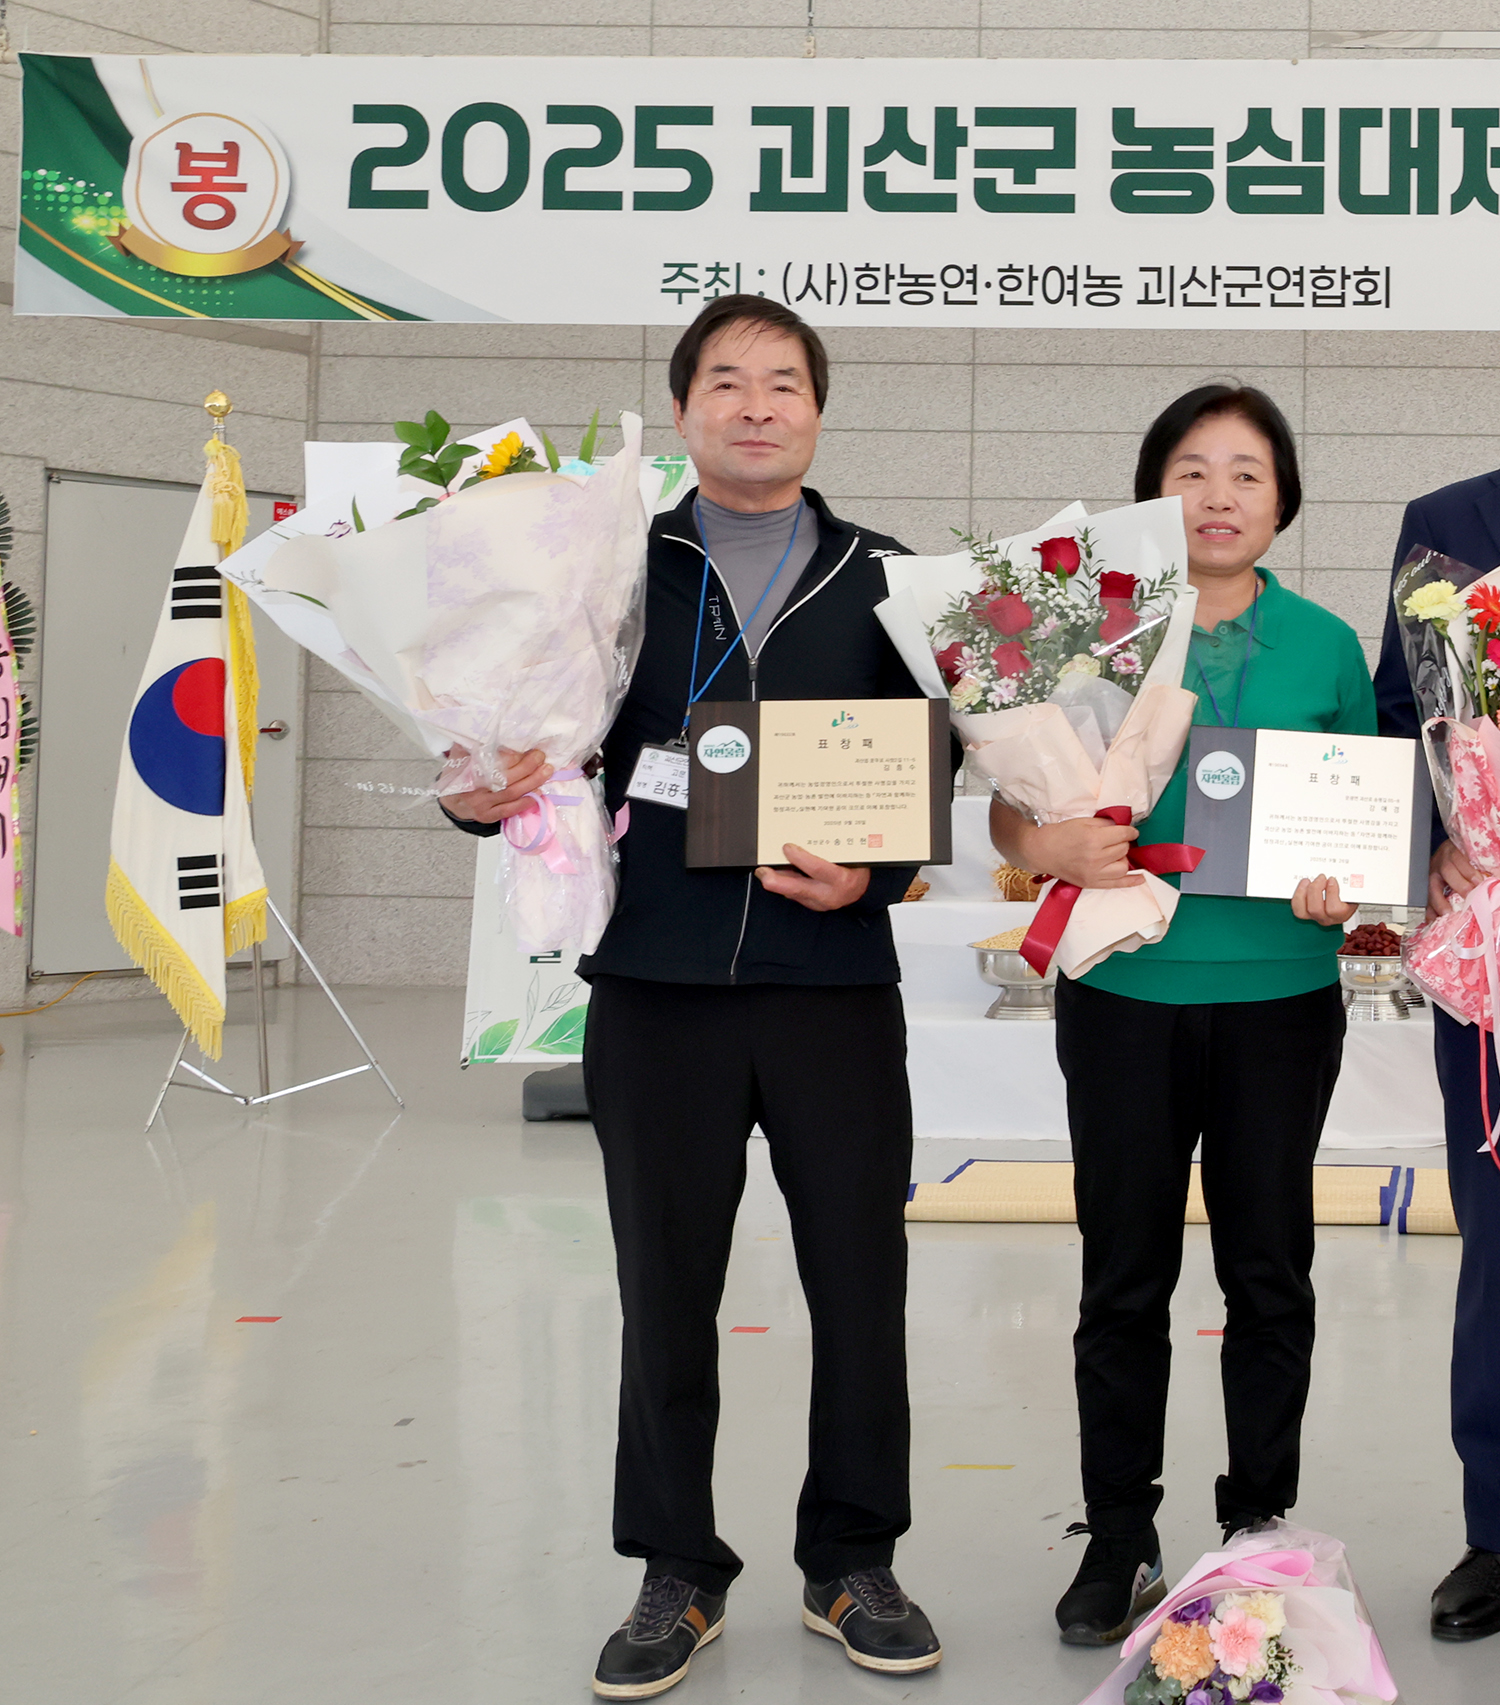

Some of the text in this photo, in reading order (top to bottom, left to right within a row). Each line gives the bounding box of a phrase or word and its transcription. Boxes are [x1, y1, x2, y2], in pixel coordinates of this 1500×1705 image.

[170, 140, 249, 231] 봉
[348, 101, 715, 213] 2025
[749, 105, 1078, 214] 괴산군
[660, 261, 741, 304] 주최
[782, 261, 1122, 309] (사)한농연·한여농
[1137, 265, 1392, 310] 괴산군연합회
